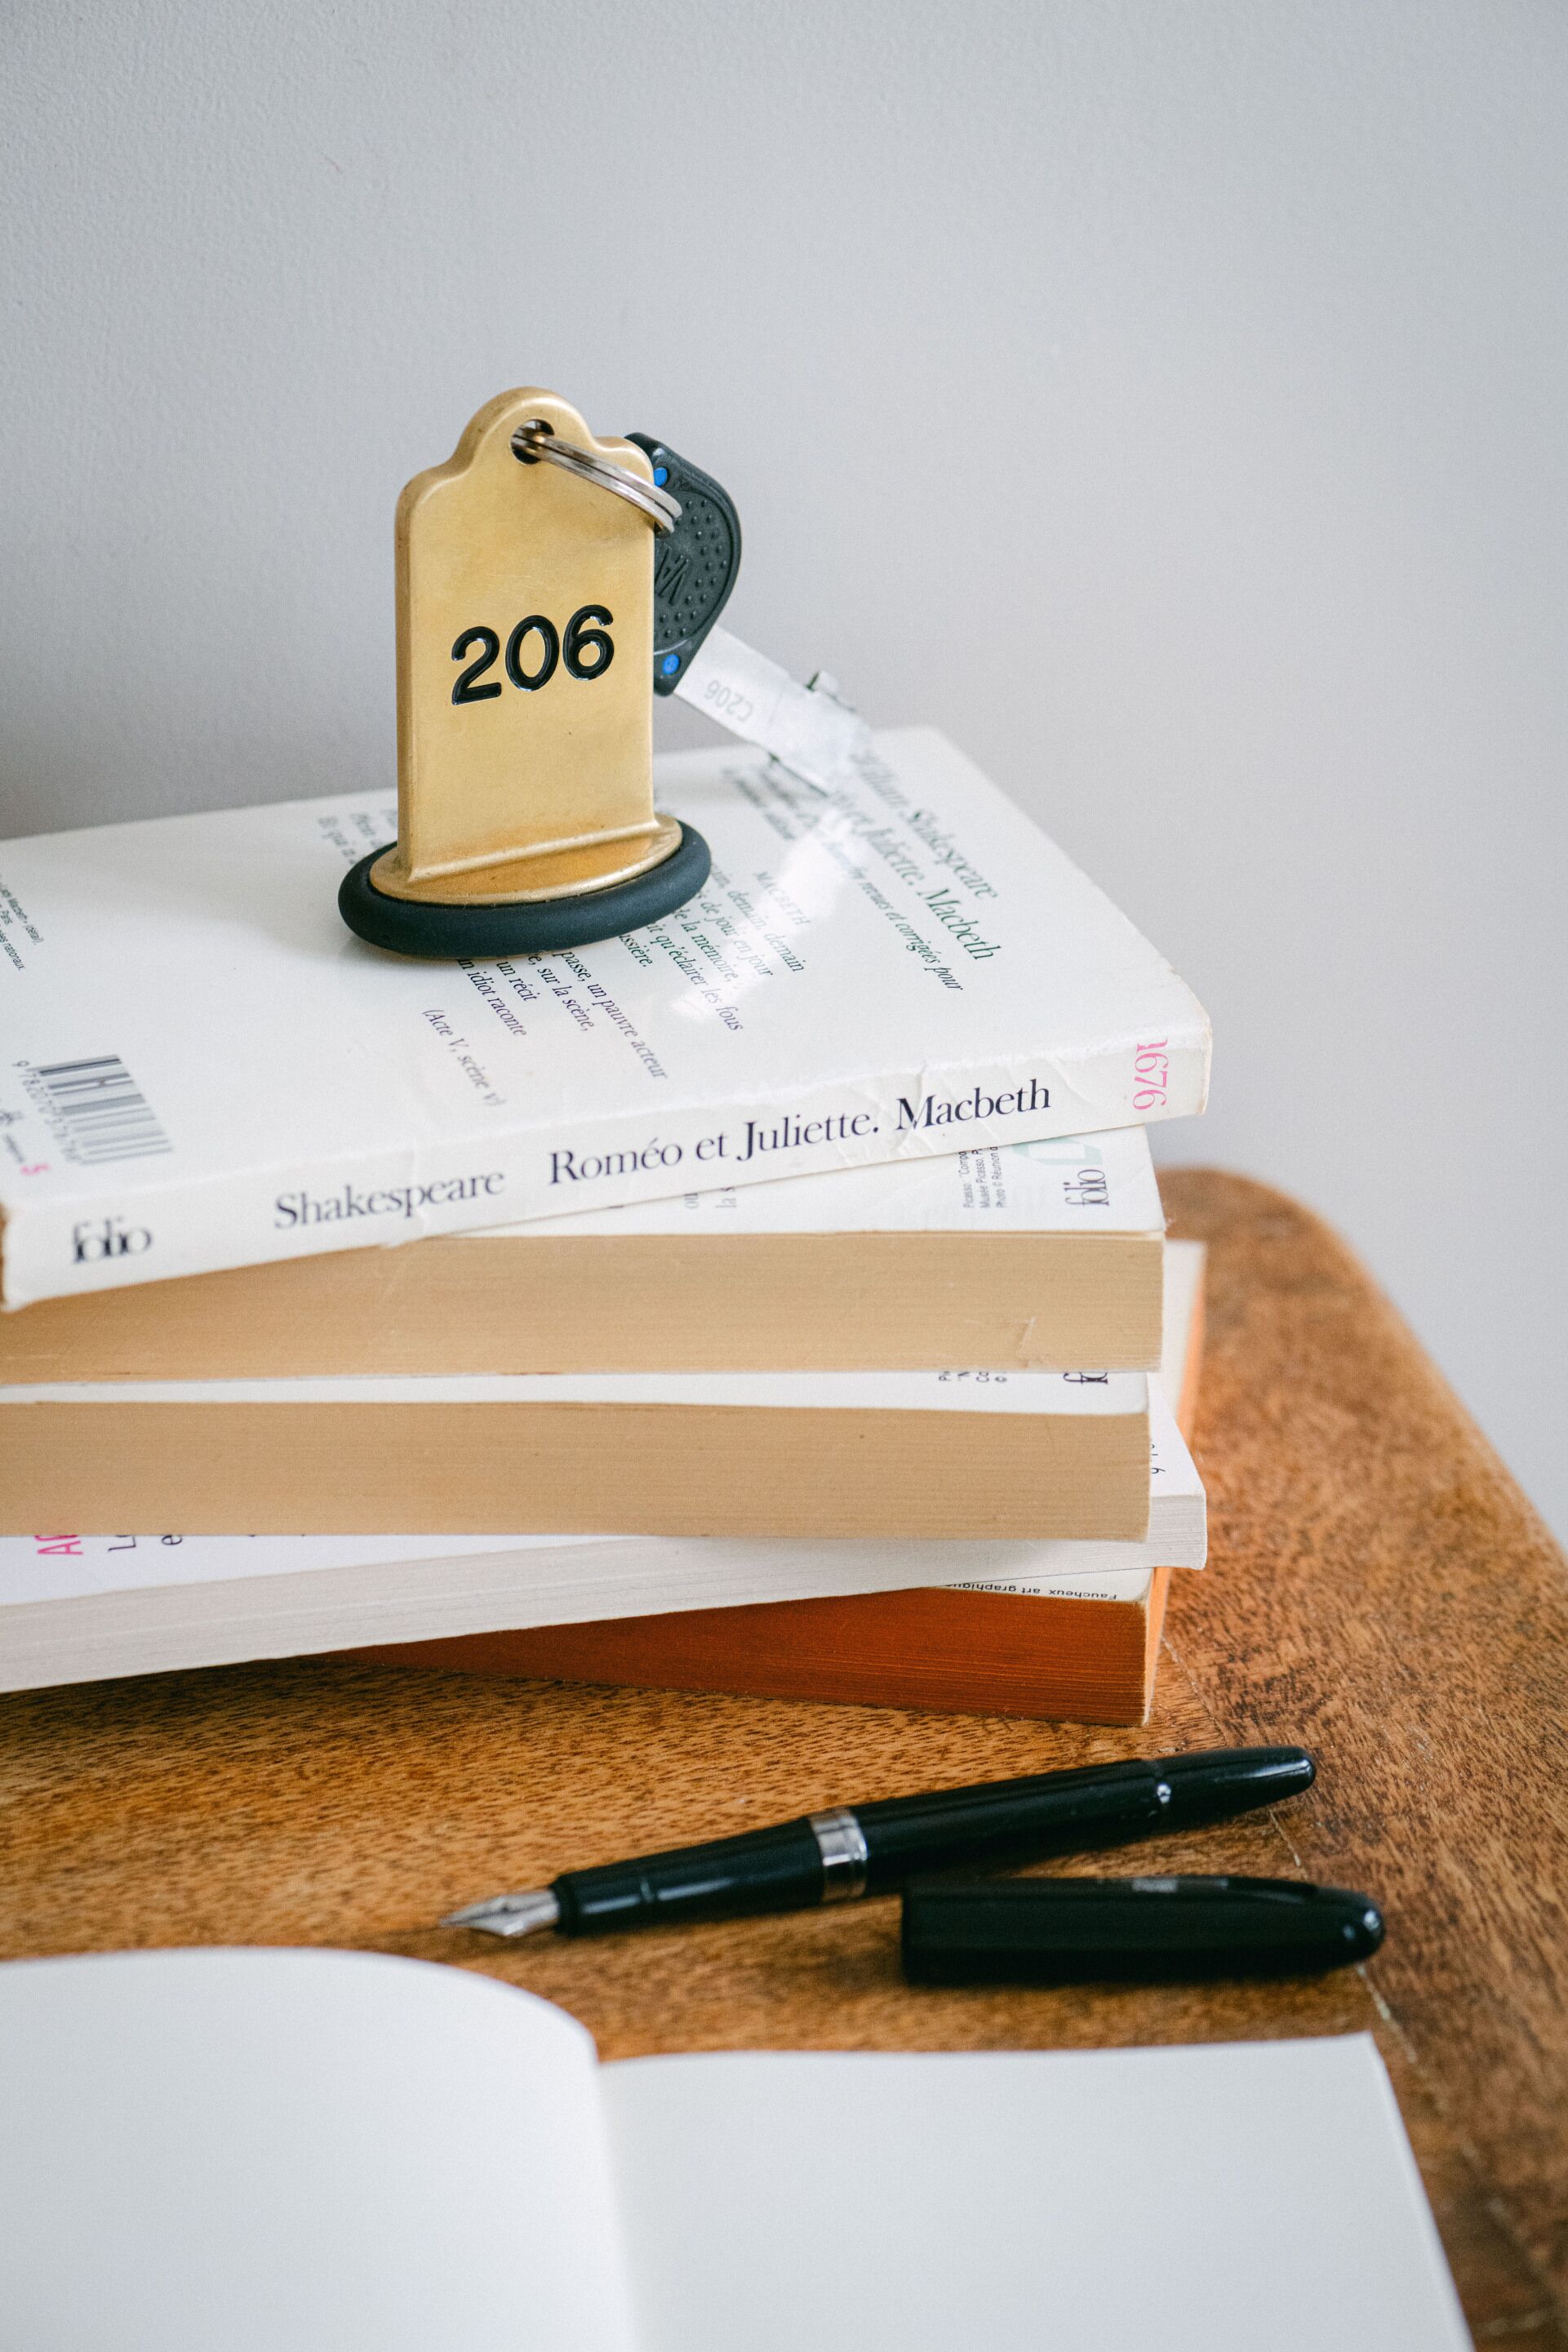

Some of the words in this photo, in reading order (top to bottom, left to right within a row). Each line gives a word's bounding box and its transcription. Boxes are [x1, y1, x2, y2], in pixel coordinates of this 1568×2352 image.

[451, 604, 614, 705] 206
[704, 678, 754, 723] C206
[681, 921, 701, 932] la
[700, 901, 722, 915] de
[736, 954, 773, 976] jour
[917, 887, 1002, 961] Macbeth
[553, 952, 592, 982] passe,
[764, 934, 806, 972] demain
[895, 923, 942, 965] corrigées
[923, 966, 964, 991] pour
[496, 962, 516, 976] un
[509, 978, 540, 1002] récit
[537, 968, 561, 984] sur
[553, 985, 572, 998] la
[587, 984, 607, 998] un
[468, 971, 496, 996] idiot
[487, 998, 527, 1037] raconte
[562, 998, 594, 1032] scène,
[592, 999, 638, 1038] pauvre
[701, 988, 722, 1005] les
[716, 1006, 744, 1030] fous
[422, 1010, 454, 1037] (Acte
[457, 1056, 490, 1089] scène
[631, 1040, 669, 1079] acteur
[73, 1216, 152, 1262] folio
[273, 1172, 505, 1229] Shakespeare
[549, 1136, 682, 1185] Roméo
[695, 1127, 731, 1160] et
[737, 1114, 882, 1160] Juliette.
[895, 1078, 1051, 1132] Macbeth
[1133, 1039, 1170, 1110] 1676
[1064, 1169, 1109, 1206] folio
[1048, 1589, 1117, 1600] Faucheux
